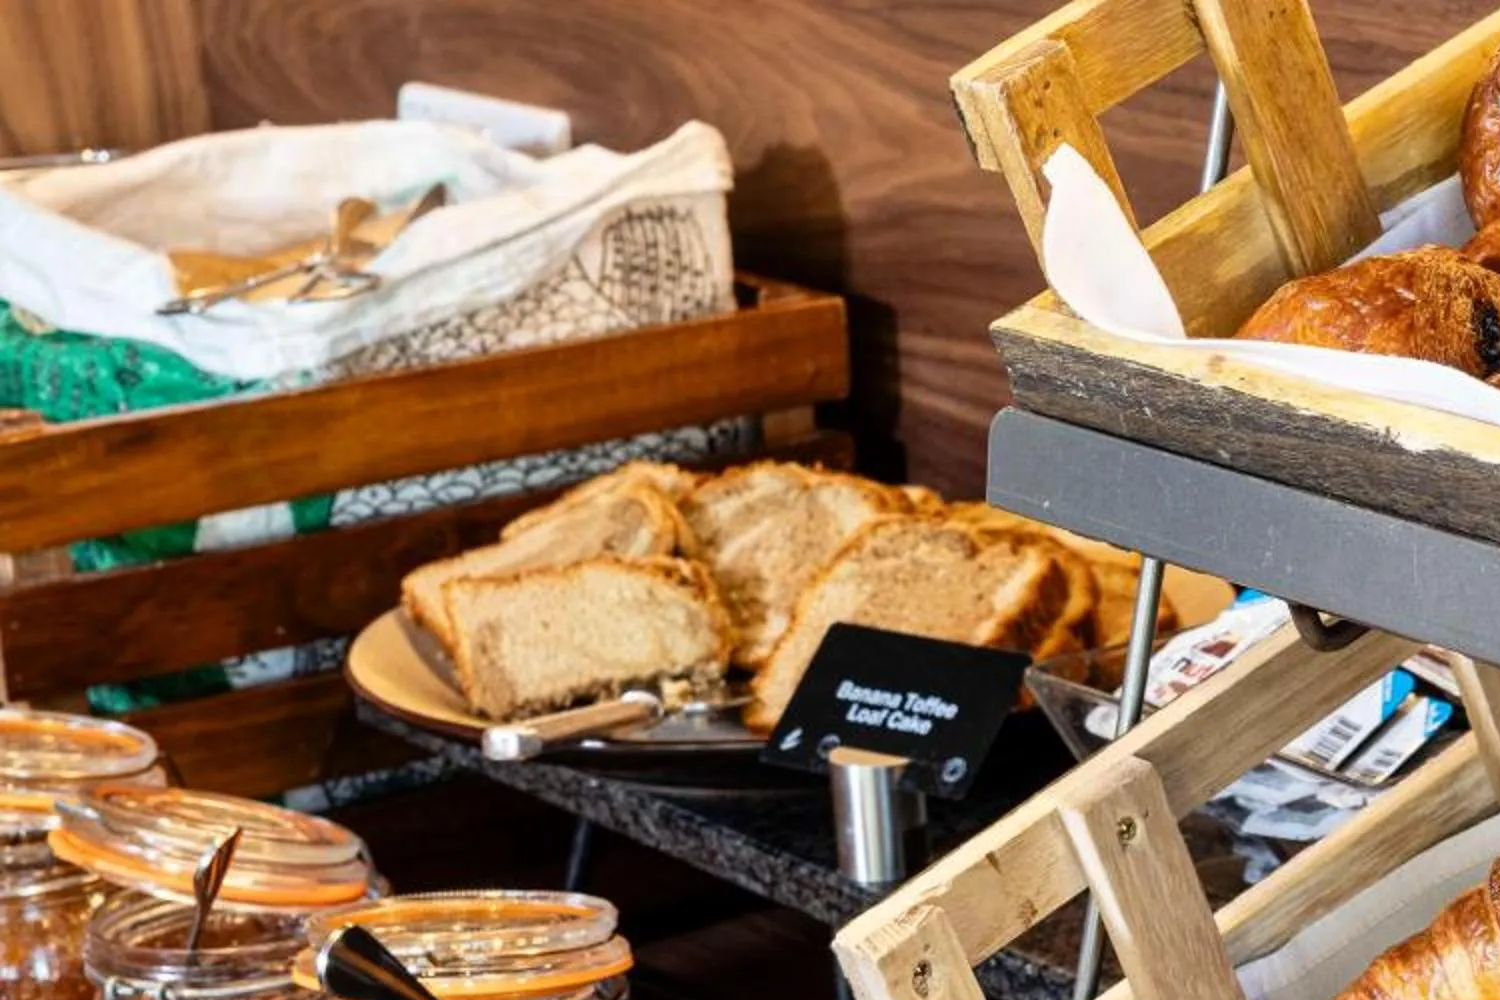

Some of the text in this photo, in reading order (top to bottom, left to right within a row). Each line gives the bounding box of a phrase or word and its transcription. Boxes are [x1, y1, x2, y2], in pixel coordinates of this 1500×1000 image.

[836, 679, 959, 720] Banana Toffee
[846, 702, 933, 735] Loaf Cake
